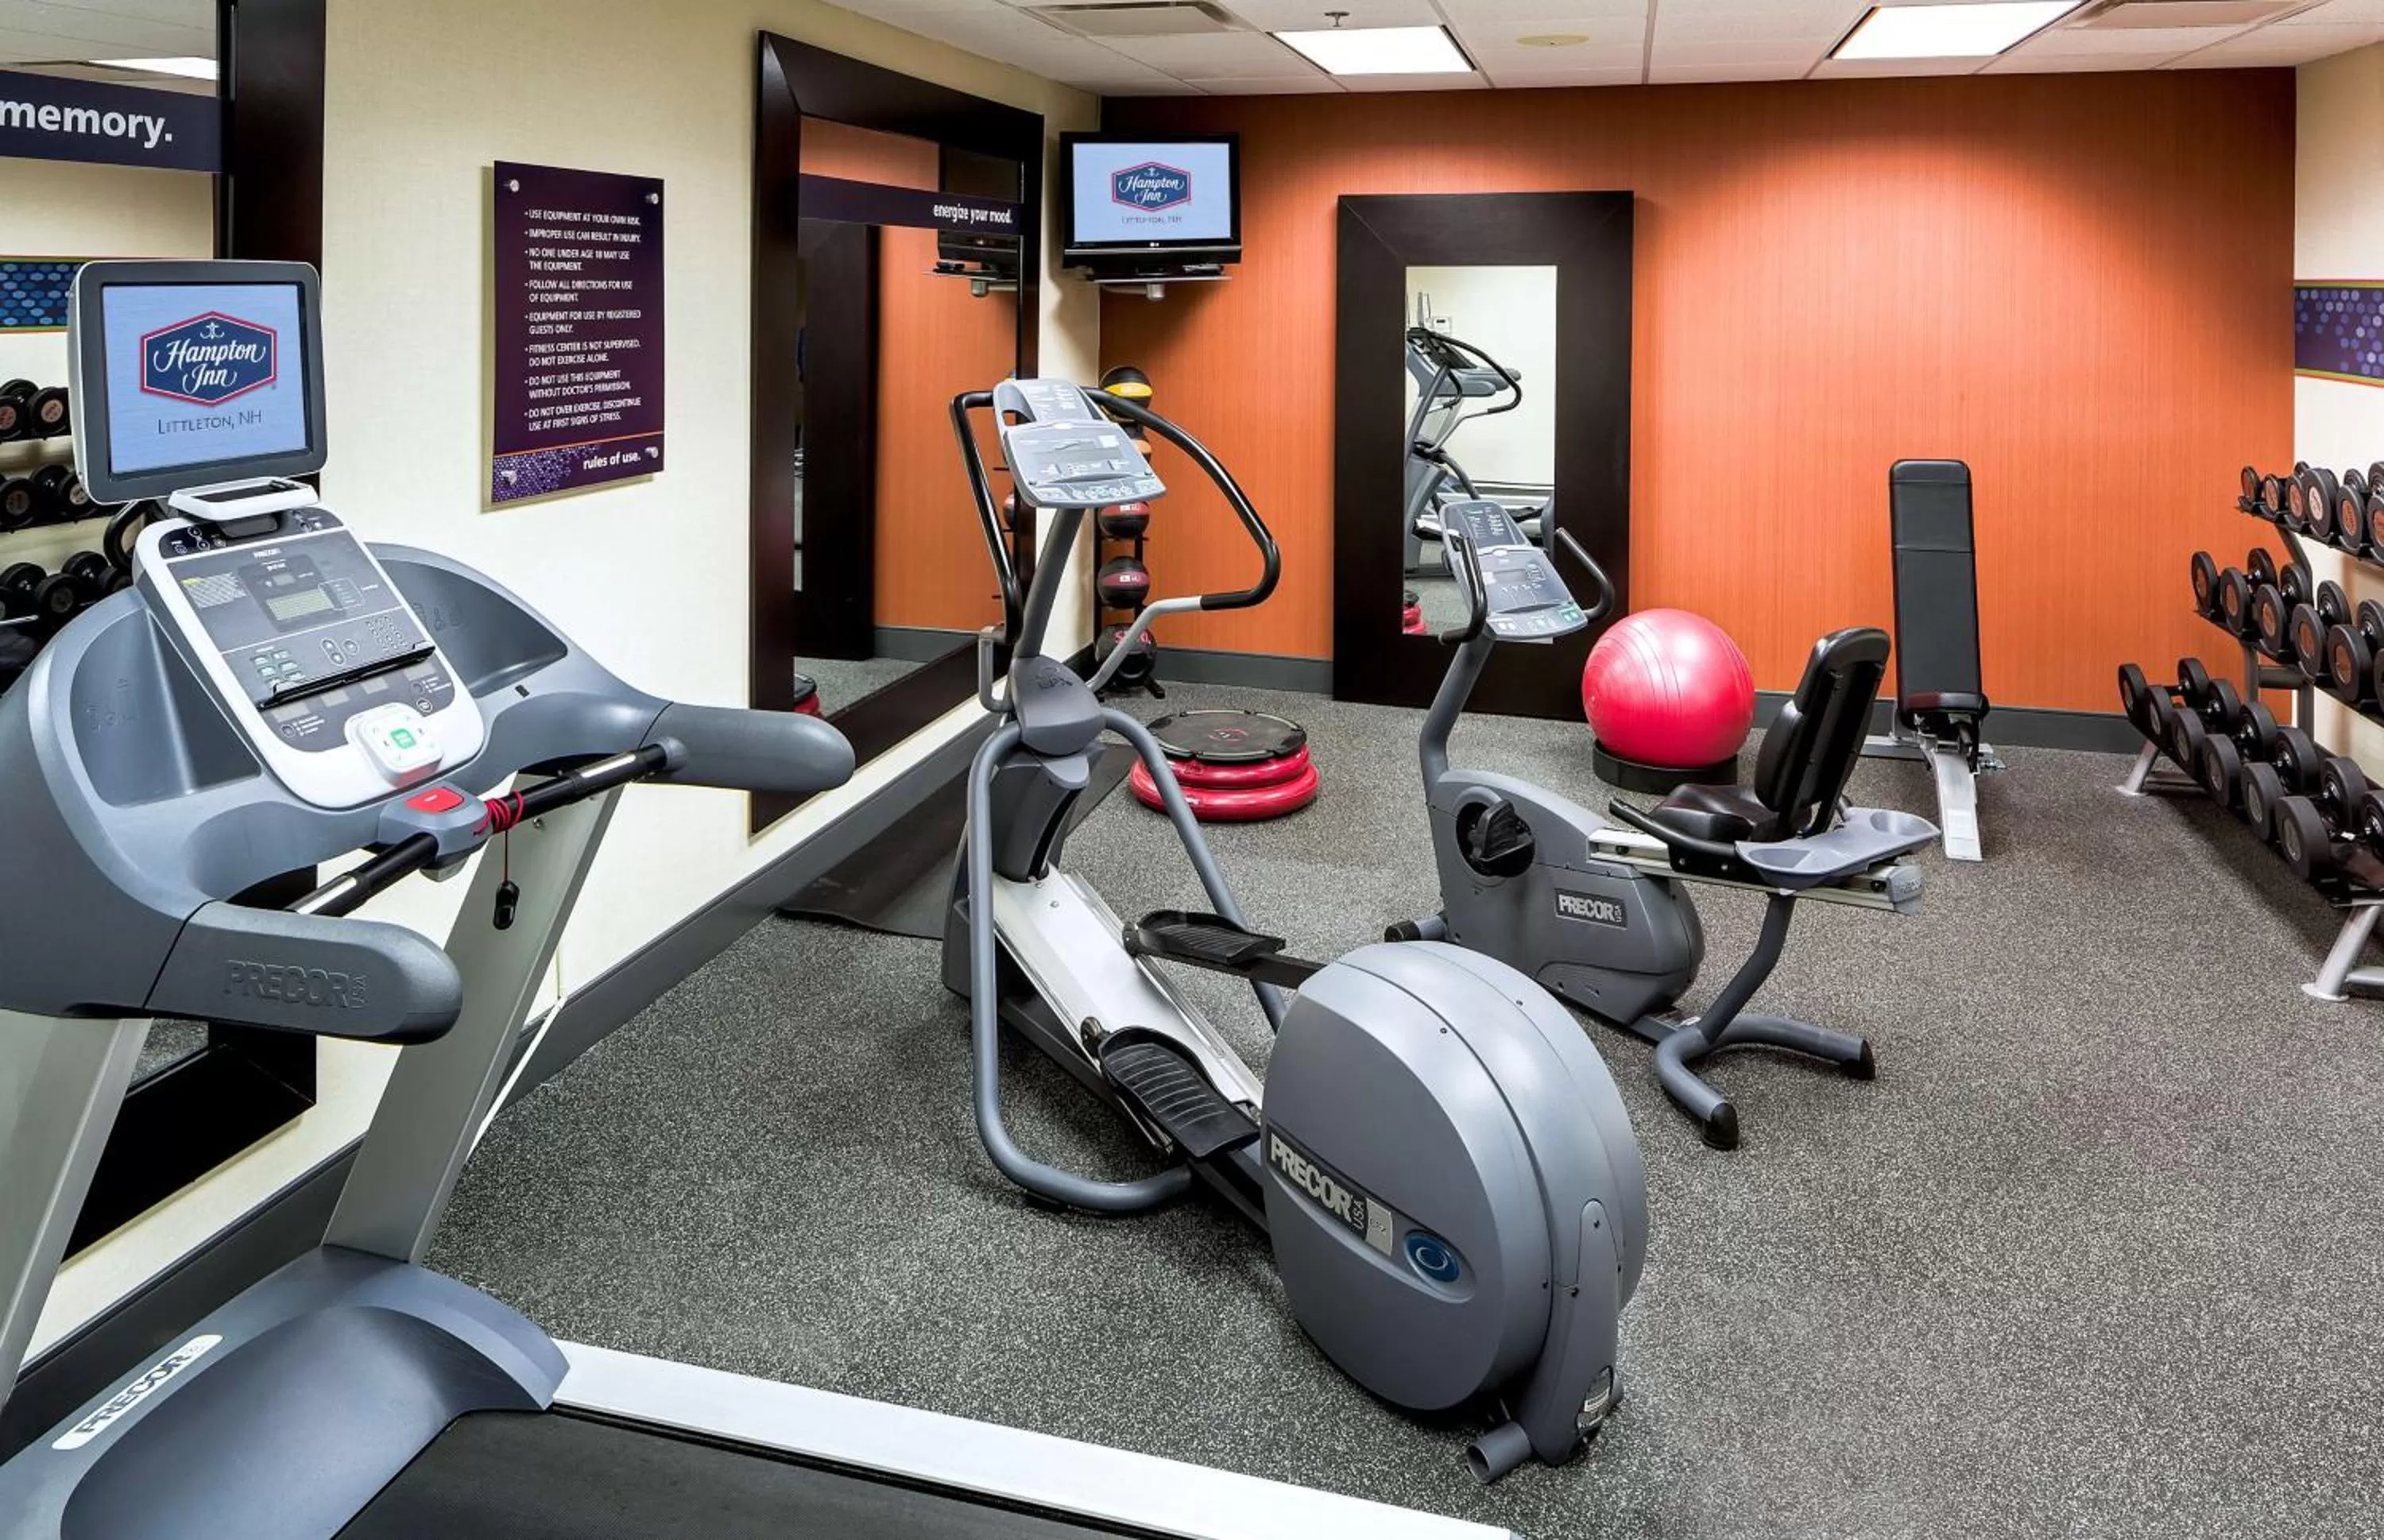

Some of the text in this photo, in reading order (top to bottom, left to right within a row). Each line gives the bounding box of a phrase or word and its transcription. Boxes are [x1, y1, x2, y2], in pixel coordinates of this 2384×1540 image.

[0, 99, 172, 149] memory.
[1118, 175, 1185, 193] Hampton
[1135, 188, 1168, 204] Inn
[528, 209, 542, 219] USE
[543, 210, 582, 222] EQUIPMENT
[933, 203, 1012, 224] energize your mood.
[563, 230, 575, 239] USE
[576, 230, 590, 241] CAN
[557, 249, 579, 258] UNDER
[580, 249, 594, 258] AGE
[529, 260, 542, 270] THE
[528, 279, 558, 289] FOLLOW
[621, 280, 633, 289] USE
[528, 293, 539, 303] OF
[583, 311, 595, 320] USE
[588, 341, 602, 350] NOT
[153, 338, 266, 373] Hampton
[528, 357, 540, 366] DO
[541, 356, 556, 366] NOT
[182, 363, 238, 394] Inn
[528, 376, 540, 386] DO
[541, 374, 556, 385] NOT
[528, 387, 561, 400] WITHOUT
[238, 410, 261, 424] NH
[528, 408, 540, 419] DO
[540, 406, 555, 416] NOT
[528, 421, 542, 431] USE
[582, 451, 641, 470] rules of use.
[1558, 894, 1615, 922] PRECOR
[223, 959, 350, 1008] PRECOR
[1271, 1132, 1364, 1229] PRECOR USA
[72, 1354, 192, 1434] PRECOR
